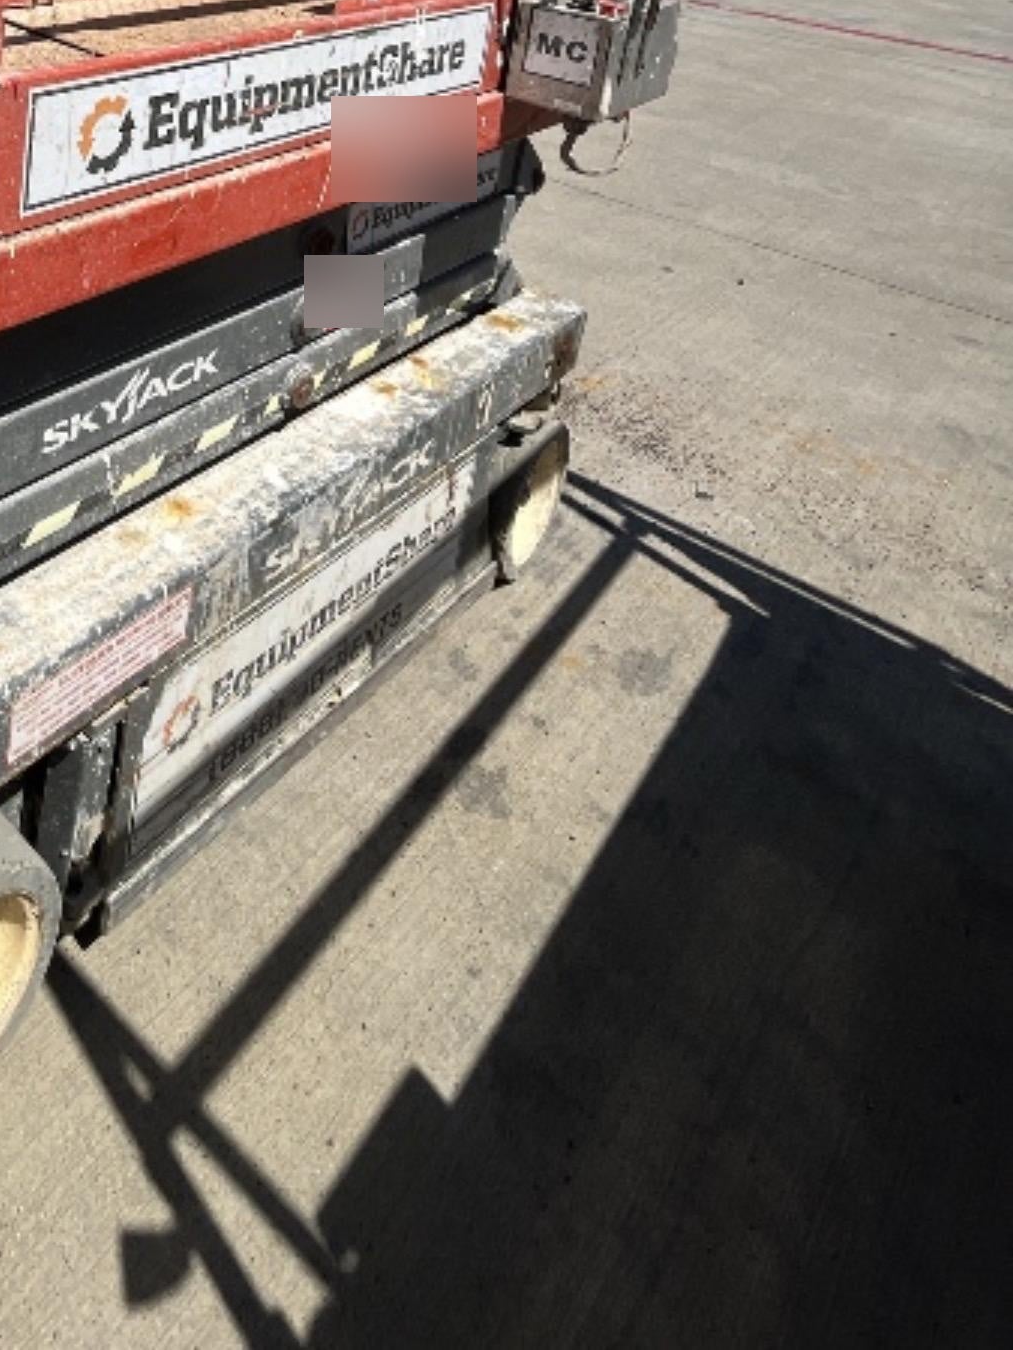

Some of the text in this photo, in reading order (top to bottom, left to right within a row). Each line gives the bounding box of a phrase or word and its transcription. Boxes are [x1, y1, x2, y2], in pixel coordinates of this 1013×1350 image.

[142, 39, 465, 151] EquipmentShare
[537, 32, 588, 64] MC
[41, 347, 219, 454] SKYJACK
